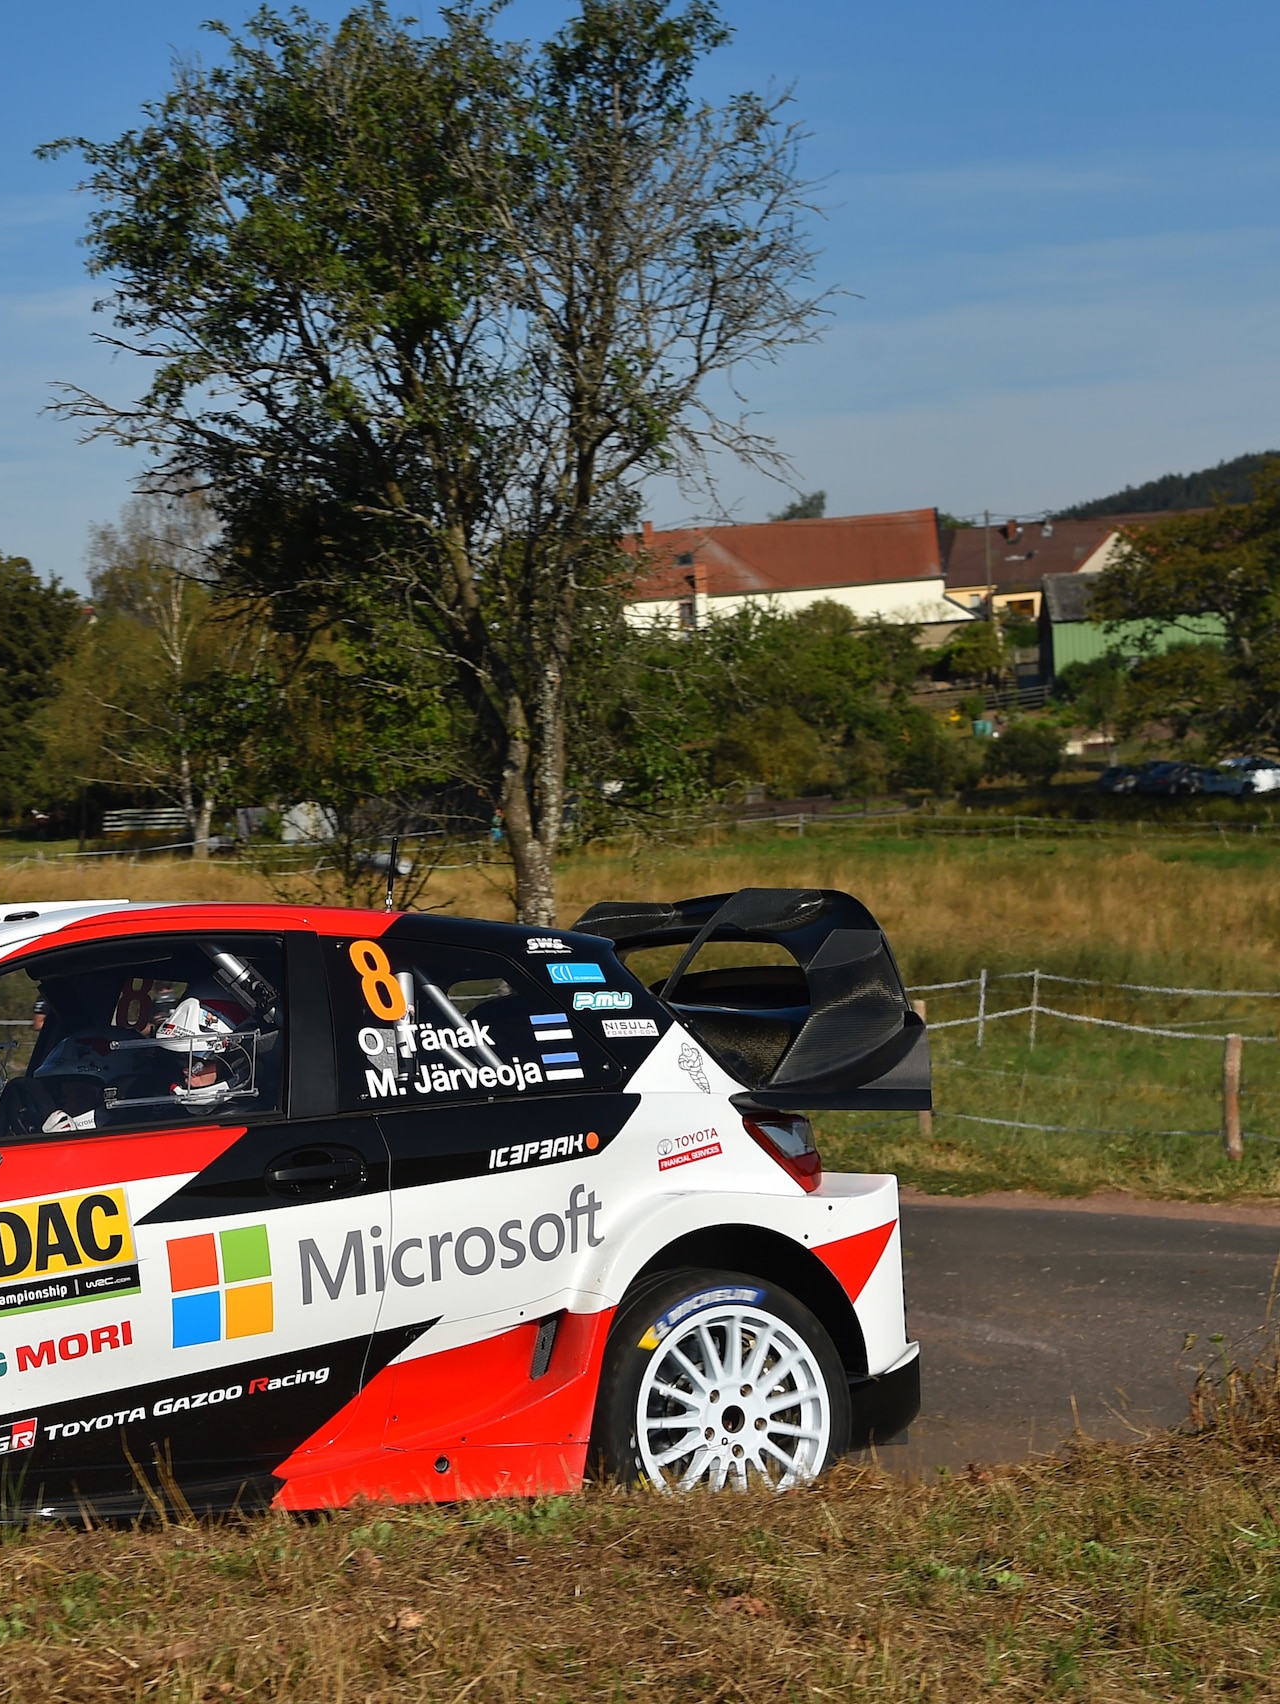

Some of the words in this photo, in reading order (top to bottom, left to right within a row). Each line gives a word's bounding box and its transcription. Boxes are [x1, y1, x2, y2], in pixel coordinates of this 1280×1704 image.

[526, 937, 563, 950] SWS
[349, 939, 407, 1021] 8
[358, 1027, 395, 1056] O.
[397, 1020, 496, 1052] Tänak
[604, 1021, 655, 1030] NISULA
[365, 1068, 407, 1099] M.
[414, 1057, 543, 1094] Järveoja
[660, 1154, 691, 1169] FINANCIAL
[691, 1145, 719, 1160] SERVICES
[674, 1127, 718, 1149] TOYOTA
[298, 1183, 605, 1306] Microsoft
[16, 1320, 133, 1372] MORI
[44, 1407, 146, 1441] TOYOTA
[153, 1384, 243, 1417] GAZOO
[248, 1366, 330, 1395] Racing
